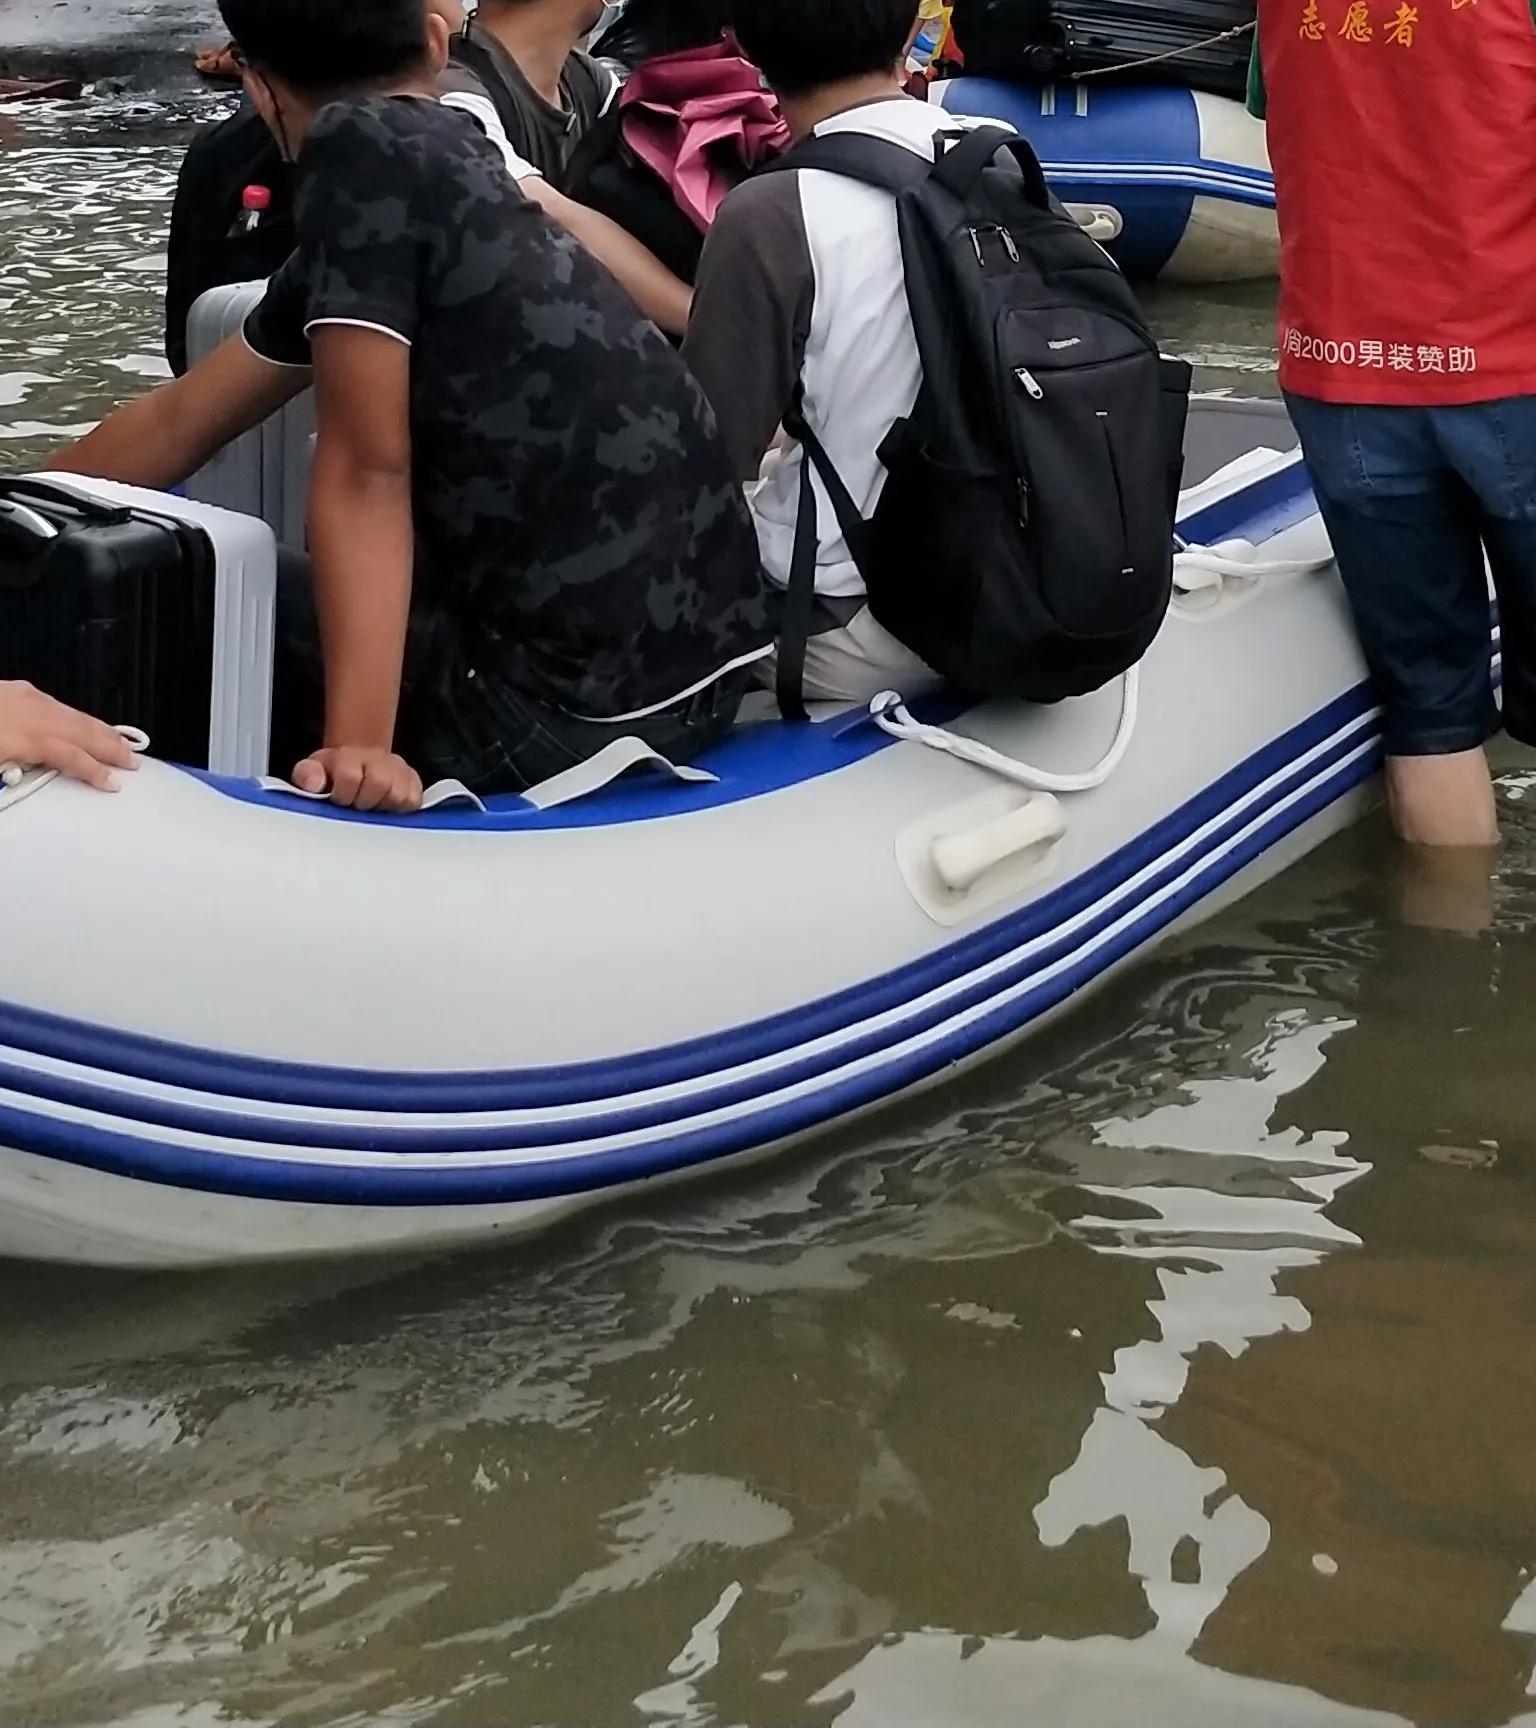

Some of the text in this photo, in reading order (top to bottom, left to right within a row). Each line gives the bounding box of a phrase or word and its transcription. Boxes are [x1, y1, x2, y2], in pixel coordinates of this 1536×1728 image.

[1283, 327, 1477, 374] 尚2000男装赞助
